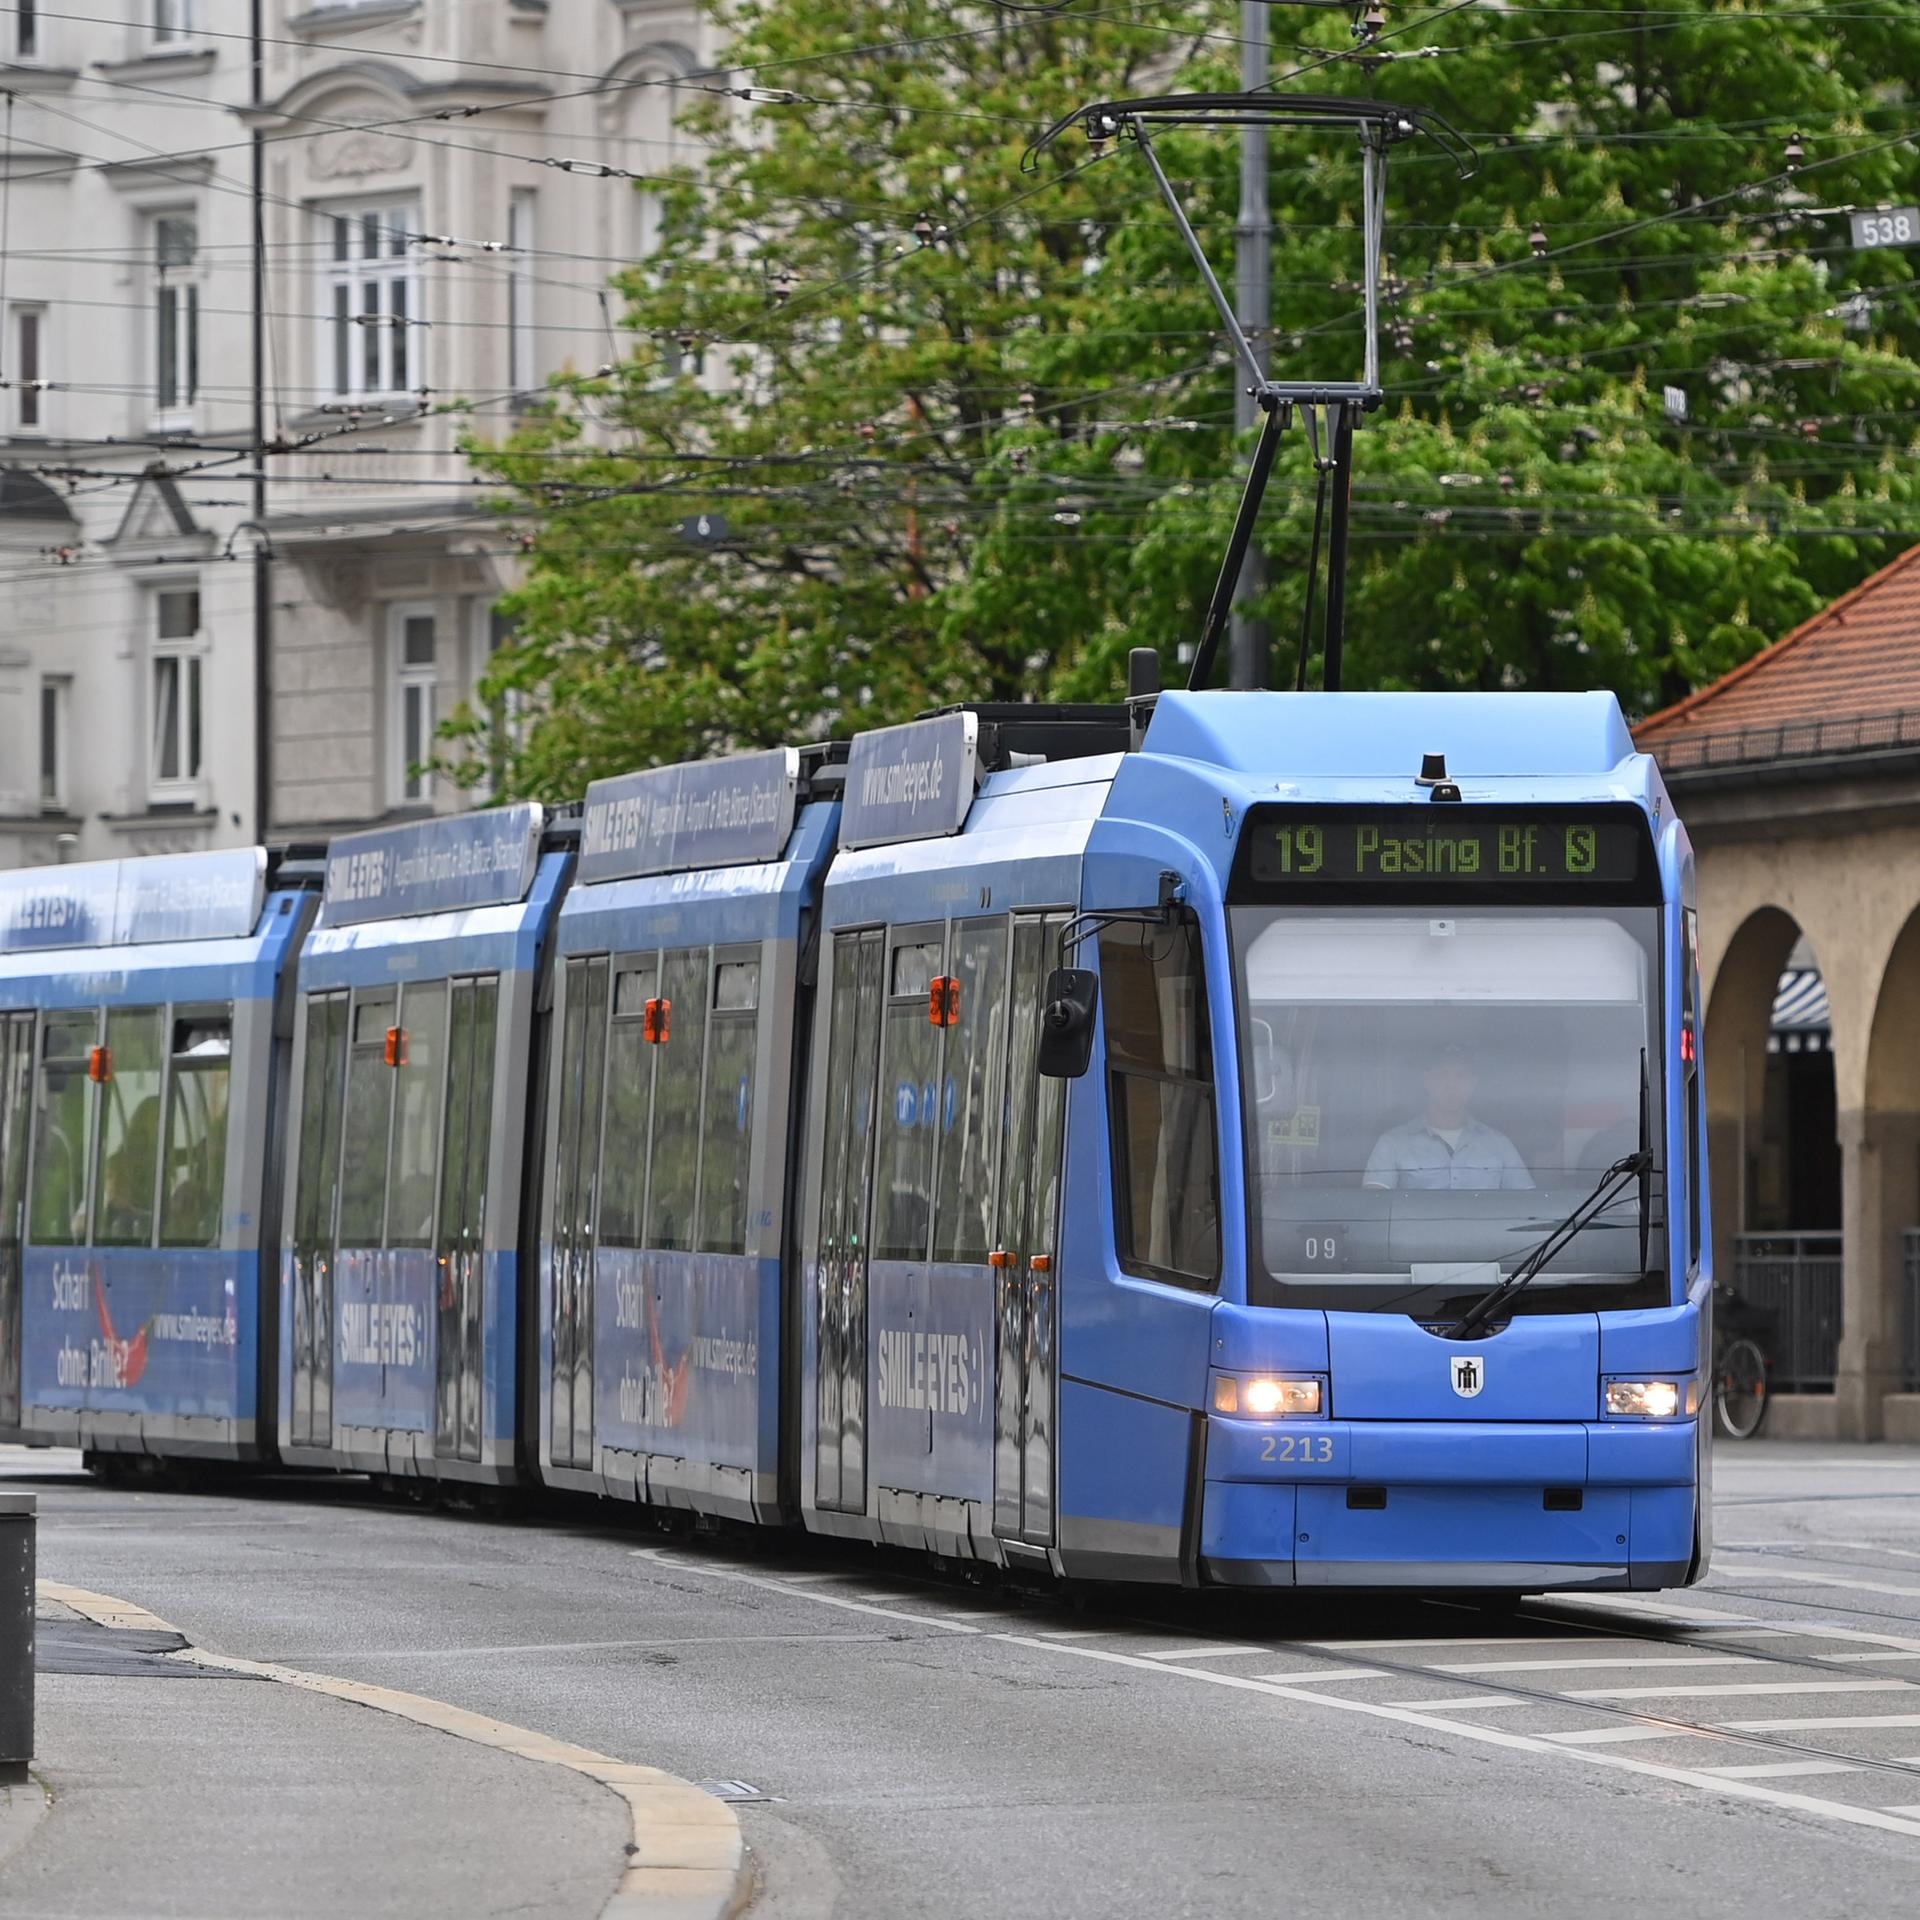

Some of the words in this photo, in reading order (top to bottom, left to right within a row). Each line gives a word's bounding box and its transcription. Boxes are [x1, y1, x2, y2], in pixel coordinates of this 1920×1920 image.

[1862, 215, 1911, 247] 538
[862, 742, 943, 816] www.smileeyes.de
[1276, 824, 1324, 873] 19
[1356, 825, 1480, 873] Pasing
[1499, 825, 1547, 873] Bf.
[57, 1333, 88, 1388] ohne
[341, 1302, 379, 1364] SMILE
[380, 1303, 416, 1367] EYES
[878, 1328, 924, 1409] SMILE
[927, 1333, 969, 1416] EYES
[1260, 1436, 1334, 1463] 2213
